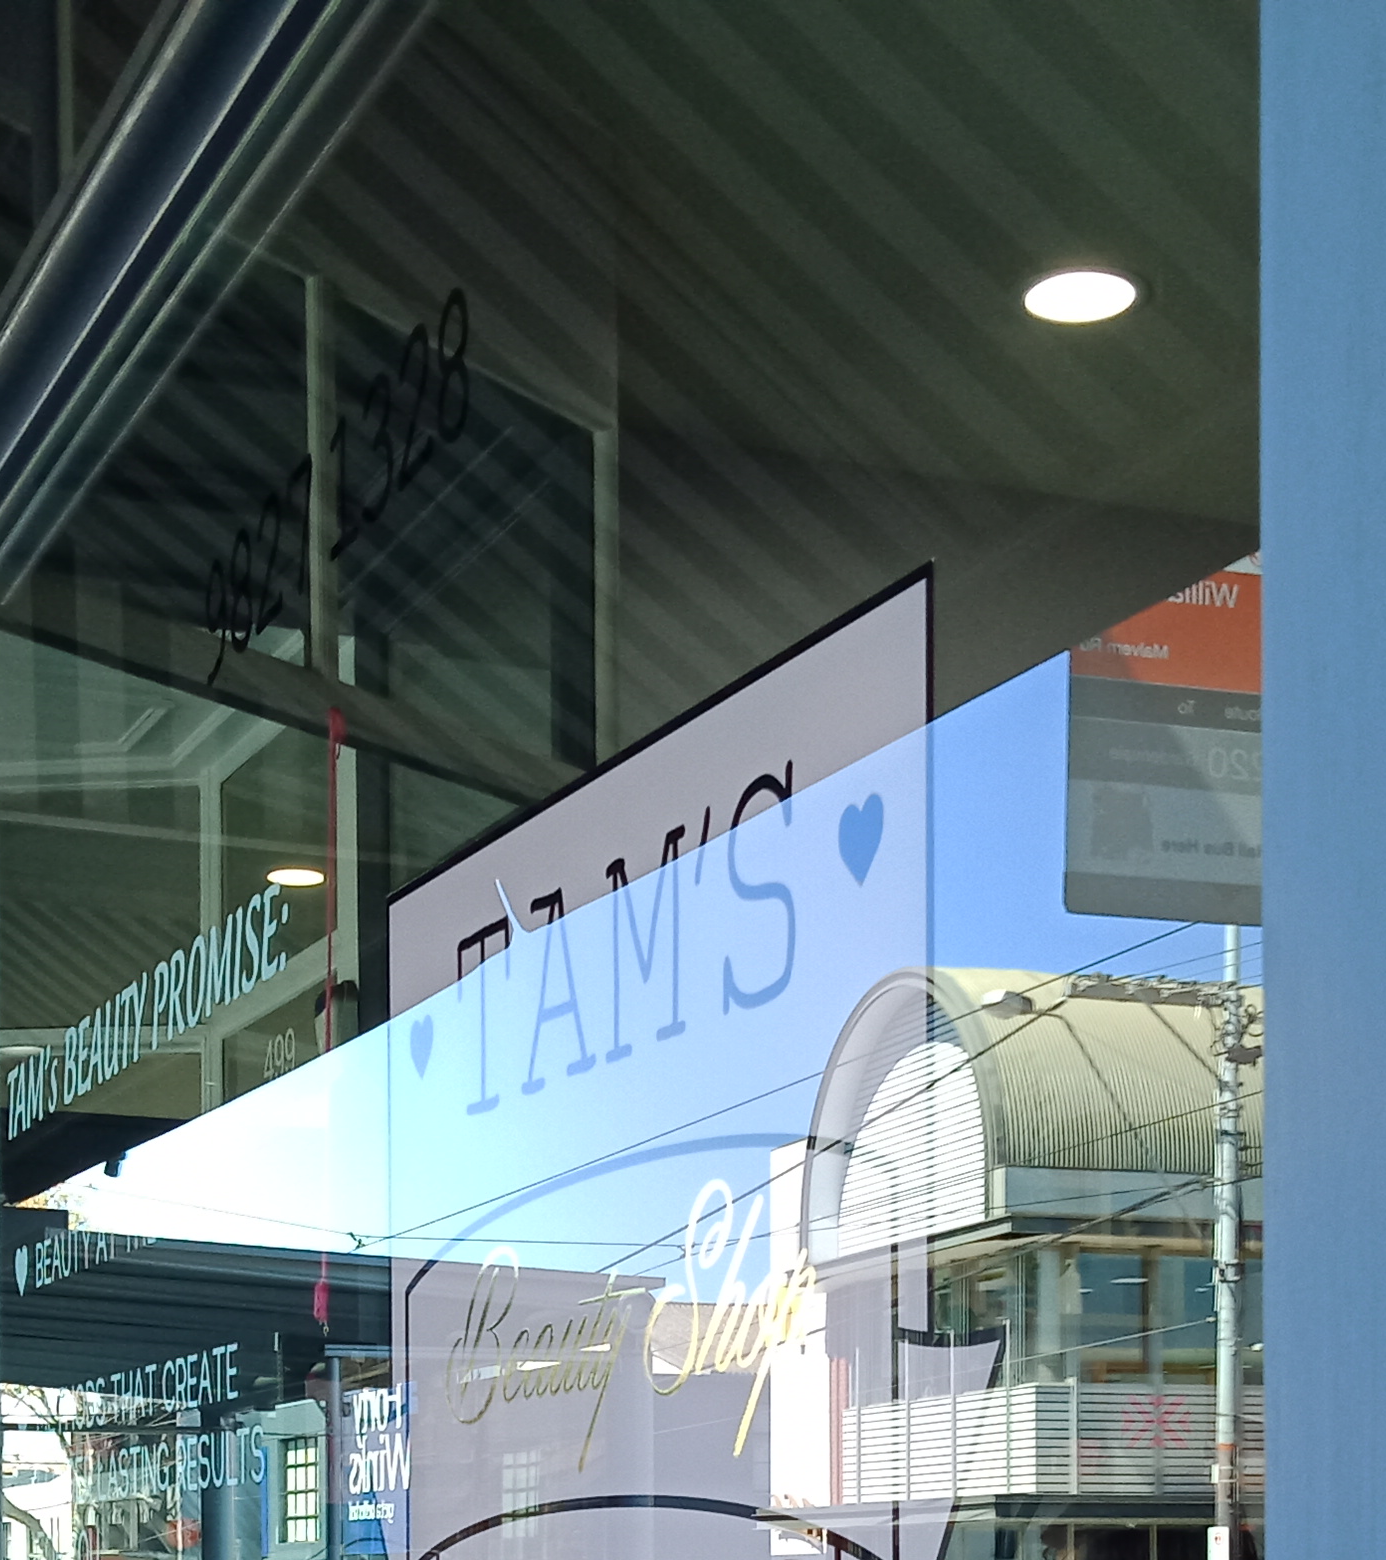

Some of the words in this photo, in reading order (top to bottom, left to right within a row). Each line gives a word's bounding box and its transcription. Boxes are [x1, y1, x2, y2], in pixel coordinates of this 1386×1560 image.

[206, 455, 313, 685] 9827
[330, 287, 470, 561] 1328
[63, 970, 148, 1107] BEAUTY
[151, 883, 290, 1051] PROMISE:
[34, 1230, 92, 1289] BEAUTY
[447, 1246, 646, 1473] Beauty
[643, 1179, 816, 1459] Shop
[97, 1441, 171, 1501] LASTING
[176, 1424, 265, 1493] RESULTS
[111, 1363, 159, 1428] THAT
[162, 1342, 240, 1413] CREATE
